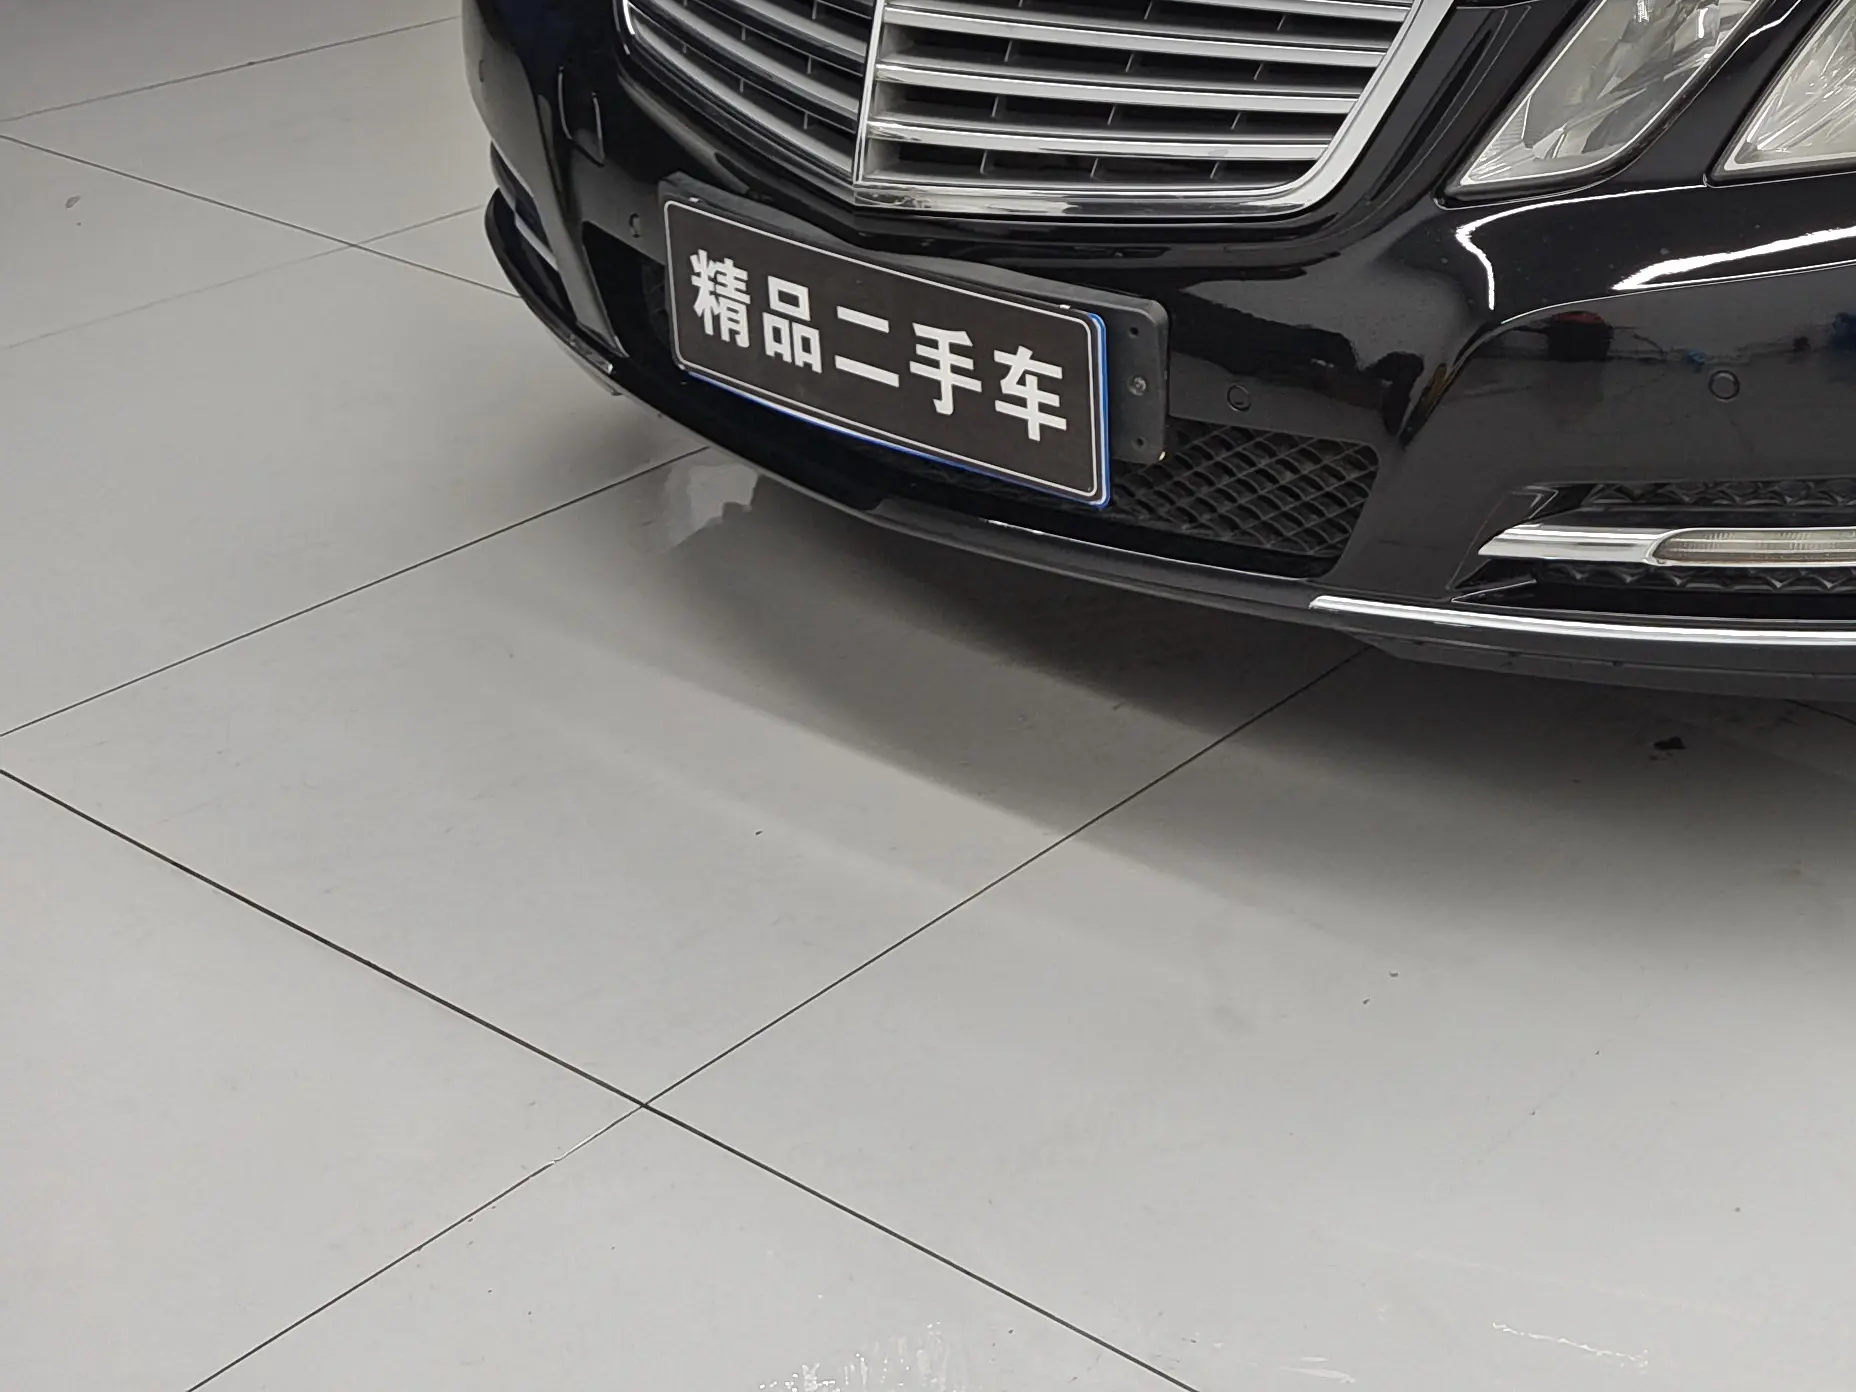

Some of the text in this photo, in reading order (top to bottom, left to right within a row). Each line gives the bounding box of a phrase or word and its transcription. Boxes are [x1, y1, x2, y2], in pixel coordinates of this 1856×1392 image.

[690, 249, 1067, 442] 精品二手车
